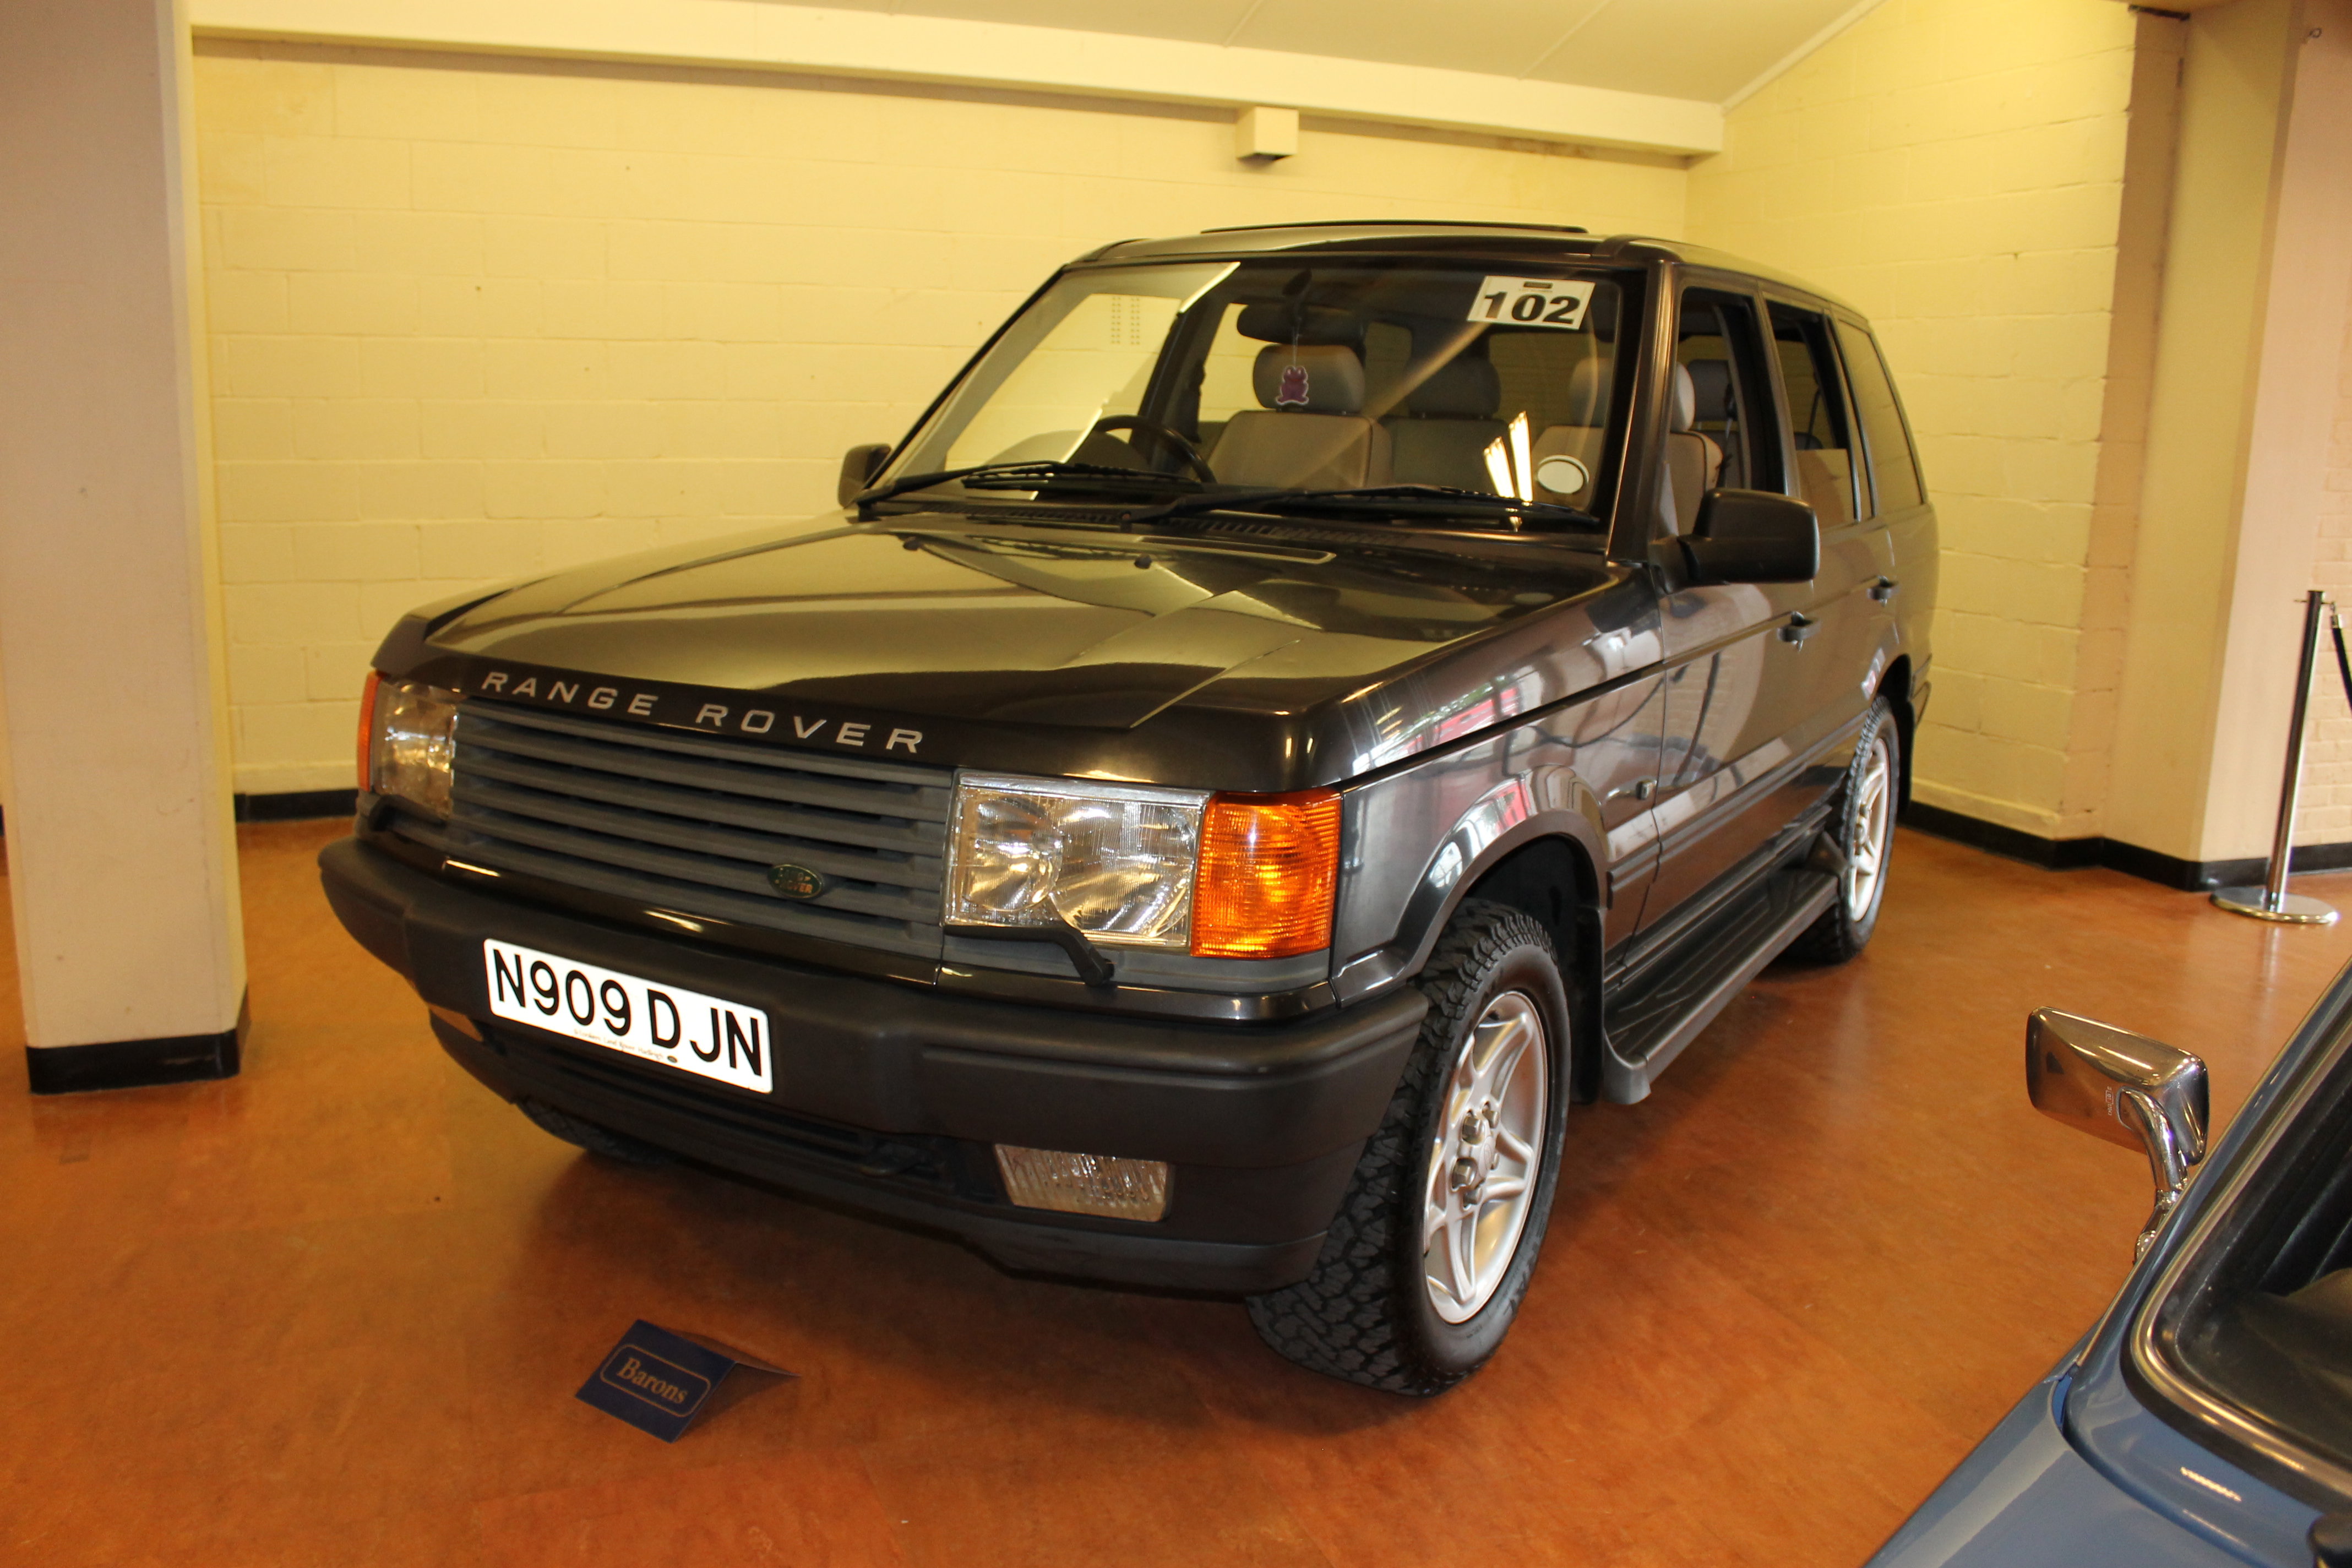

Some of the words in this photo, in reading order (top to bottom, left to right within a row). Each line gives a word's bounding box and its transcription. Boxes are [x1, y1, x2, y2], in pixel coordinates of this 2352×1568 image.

[1484, 291, 1581, 324] 102
[481, 671, 659, 717] RANGE
[695, 704, 924, 754] ROVER
[493, 948, 631, 1037] N909
[647, 988, 763, 1077] DJN
[616, 1357, 689, 1404] Barons
